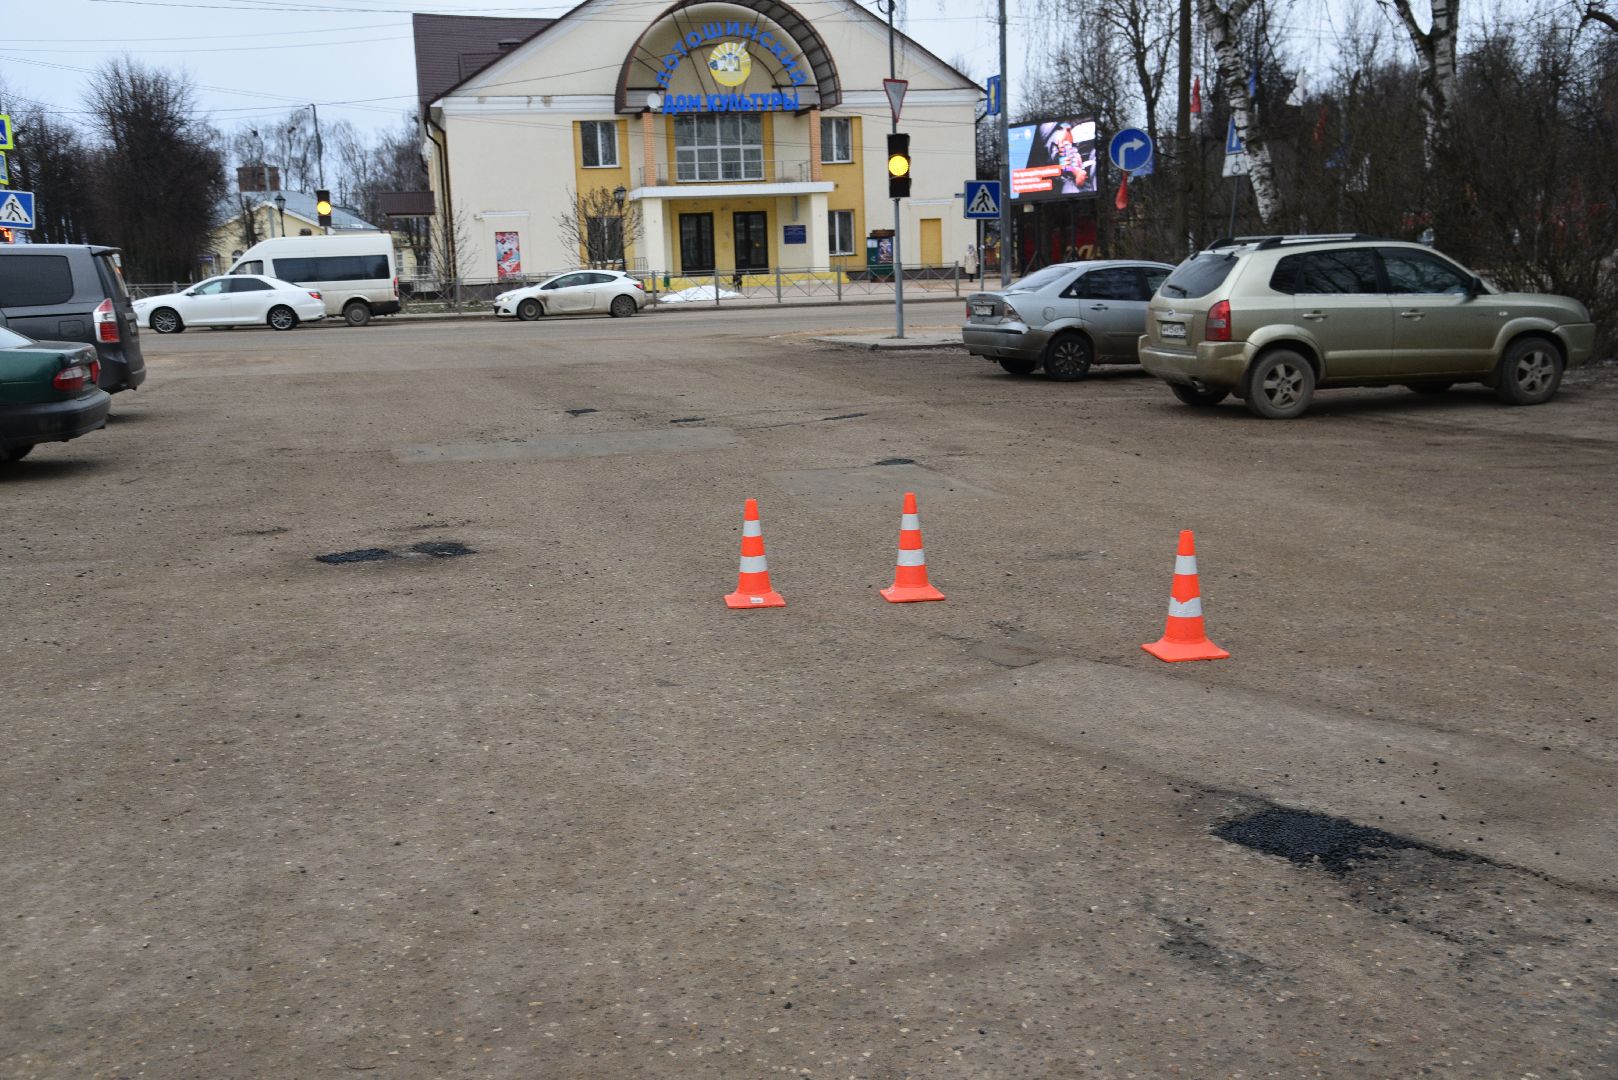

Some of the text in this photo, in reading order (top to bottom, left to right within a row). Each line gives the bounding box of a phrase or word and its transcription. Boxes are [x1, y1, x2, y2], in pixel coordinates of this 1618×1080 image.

[655, 20, 808, 88] ЛОТОШИНСКИЙ
[662, 92, 800, 115] ДОМ КУЛЬТУРЫ
